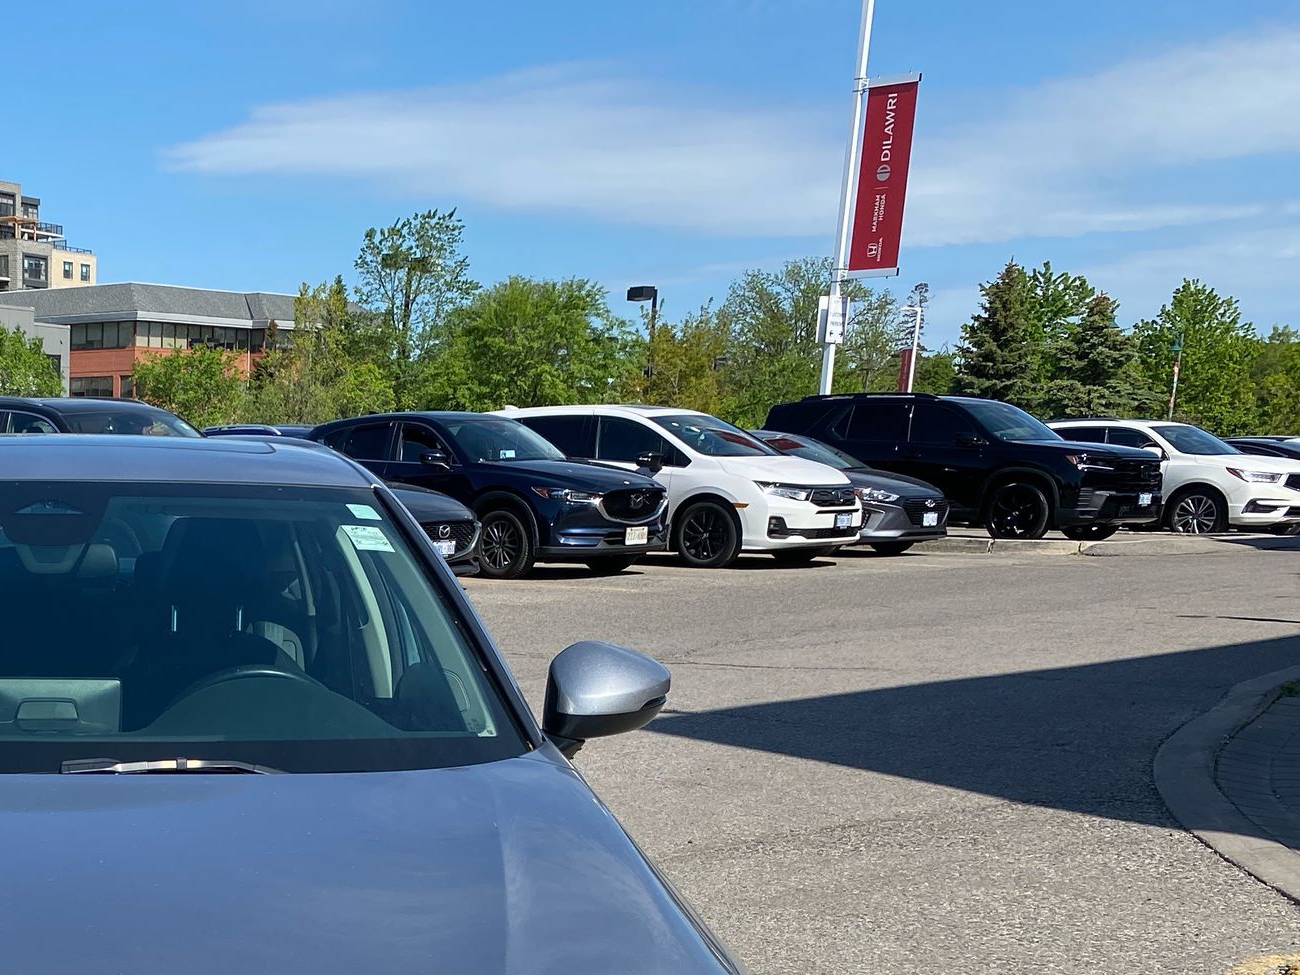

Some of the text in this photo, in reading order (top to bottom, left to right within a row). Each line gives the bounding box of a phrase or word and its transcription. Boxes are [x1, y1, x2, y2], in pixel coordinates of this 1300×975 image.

[880, 93, 898, 161] DILAWRI
[871, 194, 881, 233] MARKHAM
[878, 193, 886, 221] HONDA
